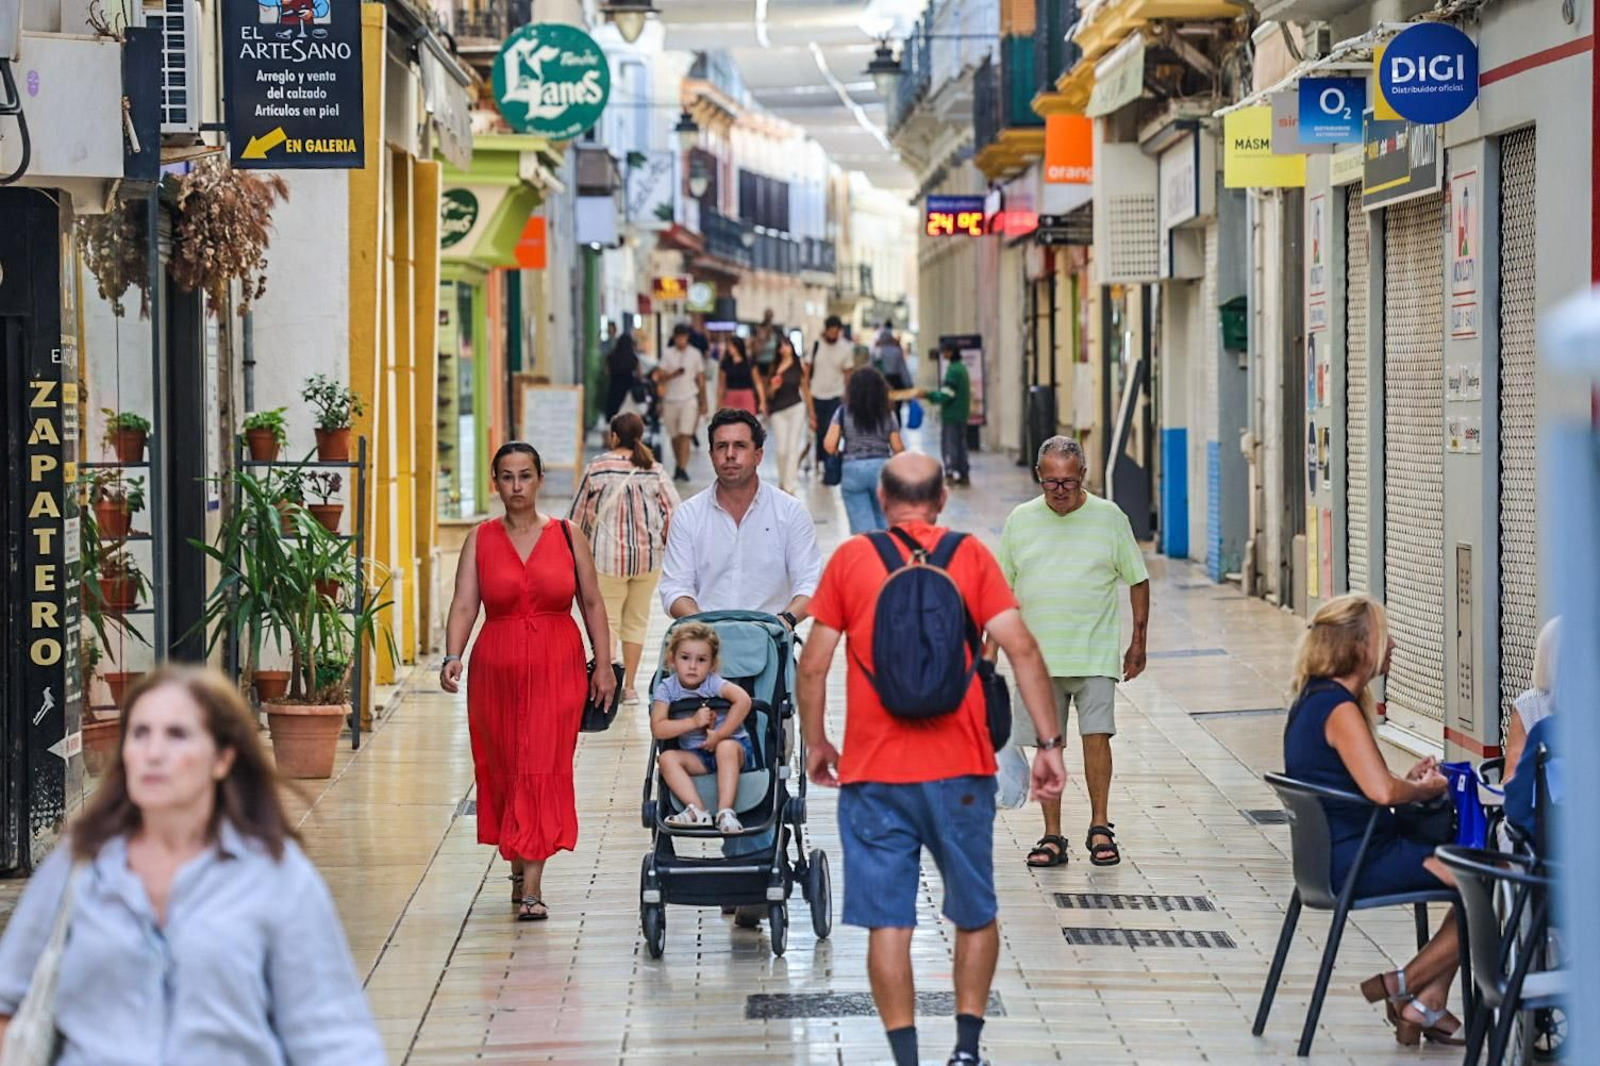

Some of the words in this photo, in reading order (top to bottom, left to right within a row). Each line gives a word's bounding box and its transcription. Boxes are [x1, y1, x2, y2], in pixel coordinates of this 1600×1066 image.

[241, 26, 264, 40] EL
[239, 40, 352, 62] ARTESANO
[1391, 54, 1465, 83] DIGI
[256, 69, 296, 84] Arreglo
[298, 72, 304, 84] y
[306, 70, 336, 82] venta
[267, 86, 284, 99] del
[286, 86, 327, 99] calzado
[1391, 85, 1437, 95] Distribuidor
[1438, 84, 1464, 93] oficial
[255, 103, 300, 117] Artículos
[303, 106, 316, 116] en
[319, 103, 339, 118] piel
[285, 139, 301, 153] EN
[305, 139, 357, 153] GALERIA
[1235, 138, 1270, 150] MÁSM
[927, 212, 954, 236] 24
[27, 381, 62, 666] ZAPATERO
